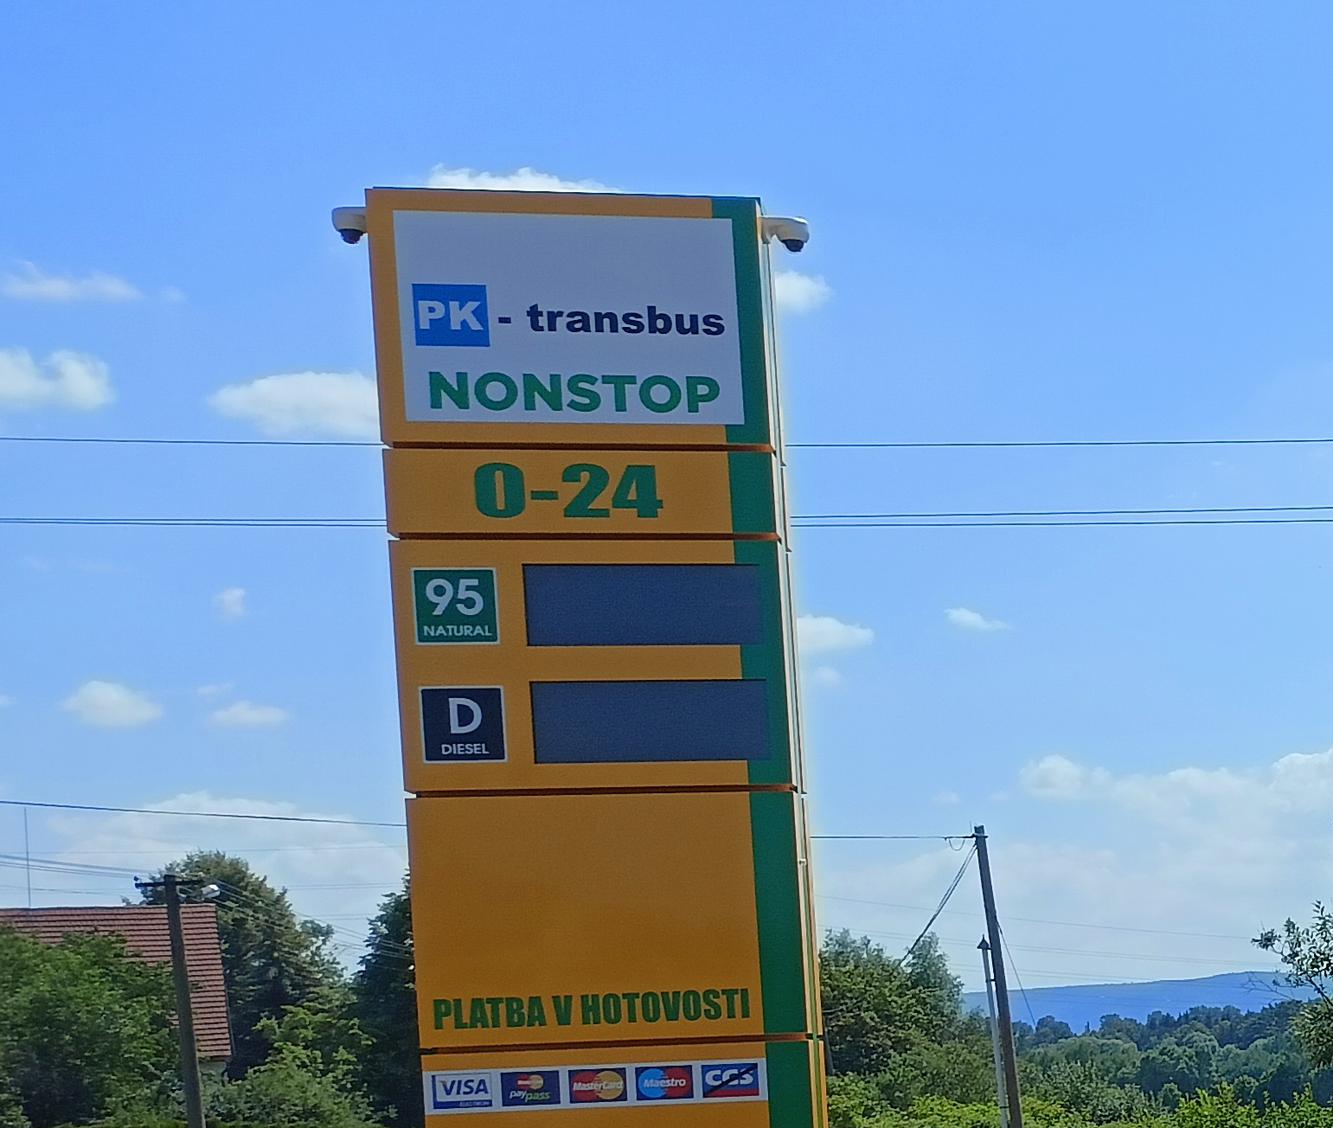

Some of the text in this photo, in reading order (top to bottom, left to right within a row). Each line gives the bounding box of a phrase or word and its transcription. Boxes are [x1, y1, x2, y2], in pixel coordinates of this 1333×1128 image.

[418, 300, 484, 331] PK
[526, 303, 725, 336] transbus
[429, 371, 720, 413] NONSTOP
[474, 462, 664, 518] 0-24
[425, 578, 484, 616] 95
[423, 625, 492, 637] NATURAL
[449, 698, 482, 735] D
[441, 743, 489, 755] DIESEL
[433, 988, 750, 1029] PLATBA V HOTOVOSTI
[440, 1079, 489, 1096] VISA
[573, 1080, 624, 1091] MasterCard
[643, 1078, 686, 1088] Maestro
